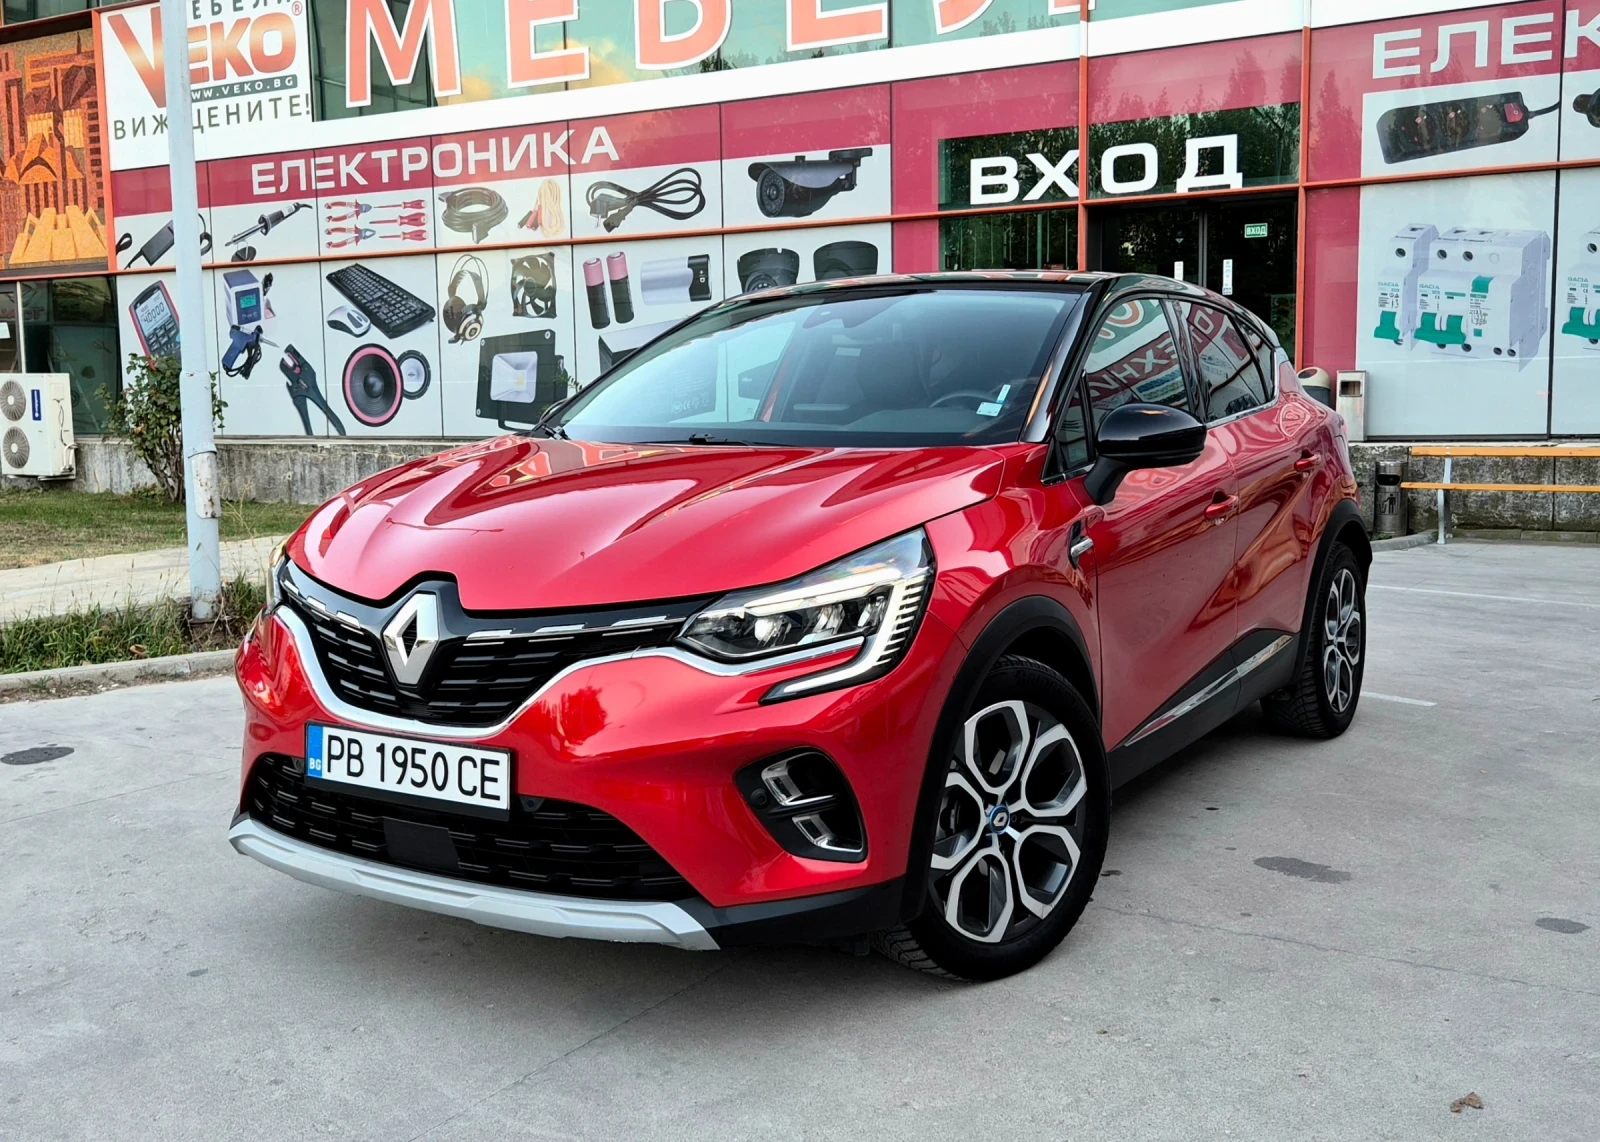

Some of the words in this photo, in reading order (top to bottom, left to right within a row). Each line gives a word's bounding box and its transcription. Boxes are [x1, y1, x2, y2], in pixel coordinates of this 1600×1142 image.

[1372, 9, 1600, 79] ЕЛЕК
[191, 76, 294, 100] WW.VEKO.BG
[114, 114, 168, 140] ВИЖ
[251, 126, 620, 195] ЕЛЕКТРОНИКА
[970, 134, 1243, 205] ВХОД
[1246, 226, 1266, 235] ВХОД
[309, 757, 322, 771] BG
[327, 734, 364, 777] PB
[376, 742, 448, 791] 1950
[457, 755, 501, 801] CE
